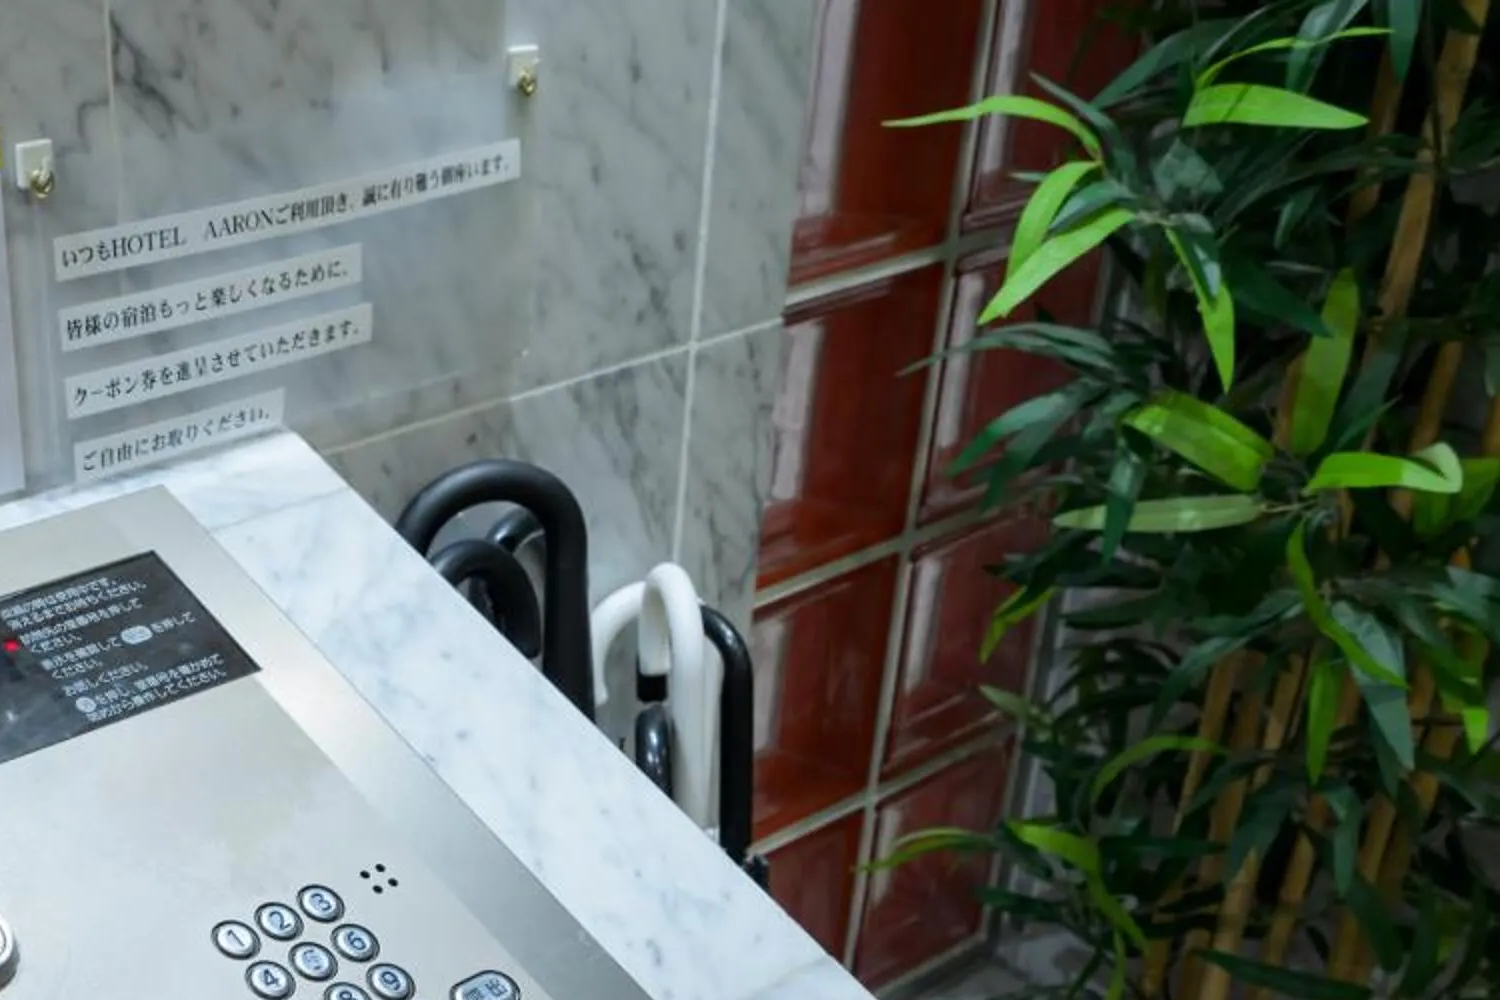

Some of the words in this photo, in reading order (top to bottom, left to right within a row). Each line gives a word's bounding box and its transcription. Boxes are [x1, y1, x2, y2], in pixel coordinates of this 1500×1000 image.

[309, 892, 332, 912] 3
[268, 910, 291, 930] 2
[226, 929, 246, 948] 1
[348, 932, 367, 952] 6
[262, 969, 280, 987] 4
[379, 971, 402, 991] 9
